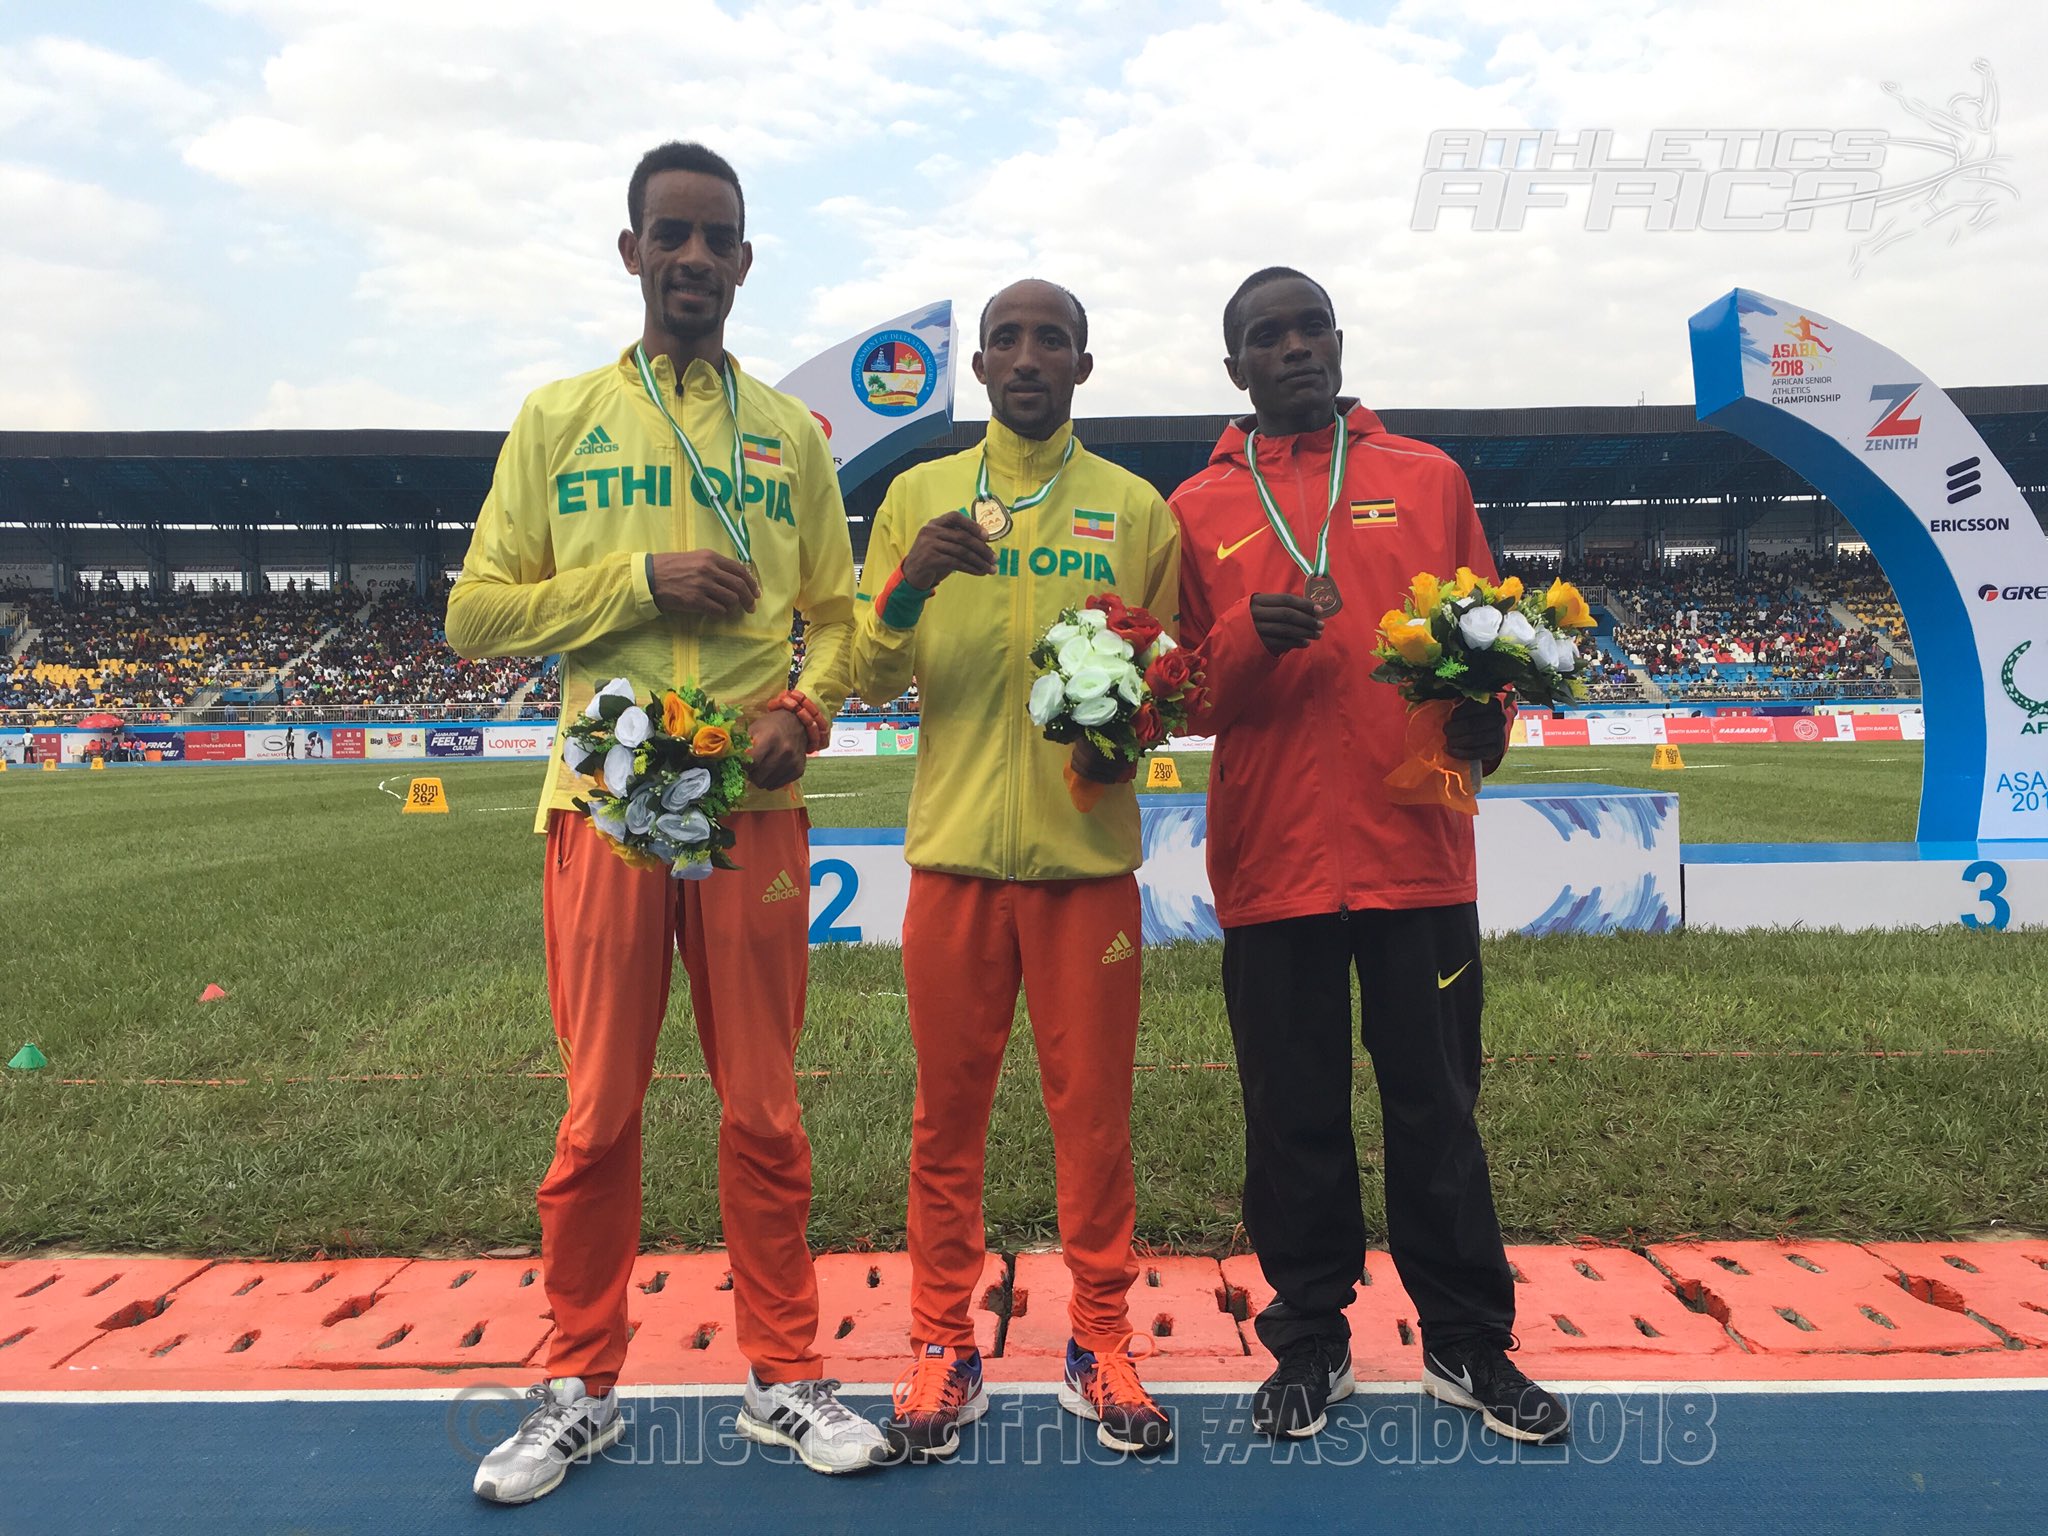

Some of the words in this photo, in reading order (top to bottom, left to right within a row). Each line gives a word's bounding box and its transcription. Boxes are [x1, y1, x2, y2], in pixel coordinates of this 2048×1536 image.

[1772, 343, 1819, 358] ASABA
[1771, 360, 1804, 377] 2018
[1772, 378, 1804, 386] AFRICAN
[1805, 376, 1832, 385] SENIOR
[1772, 386, 1811, 395] ATHLETICS
[1772, 394, 1841, 405] CHAMPIONSHIP
[574, 441, 619, 456] adidas
[1864, 438, 1919, 451] ZENITH
[1930, 517, 2010, 533] ERICSSON
[2002, 585, 2048, 601] GRE
[2020, 721, 2048, 735] AF
[145, 741, 172, 749] FRICA
[431, 736, 457, 746] FEEL
[457, 736, 479, 746] THE
[488, 739, 537, 749] LONTOR
[413, 783, 438, 793] 80m
[1996, 771, 2048, 793] ASA
[2012, 790, 2048, 812] 201
[762, 887, 800, 903] adidas
[809, 858, 862, 945] 2
[1960, 860, 2011, 932] 3
[1101, 946, 1135, 964] adidas
